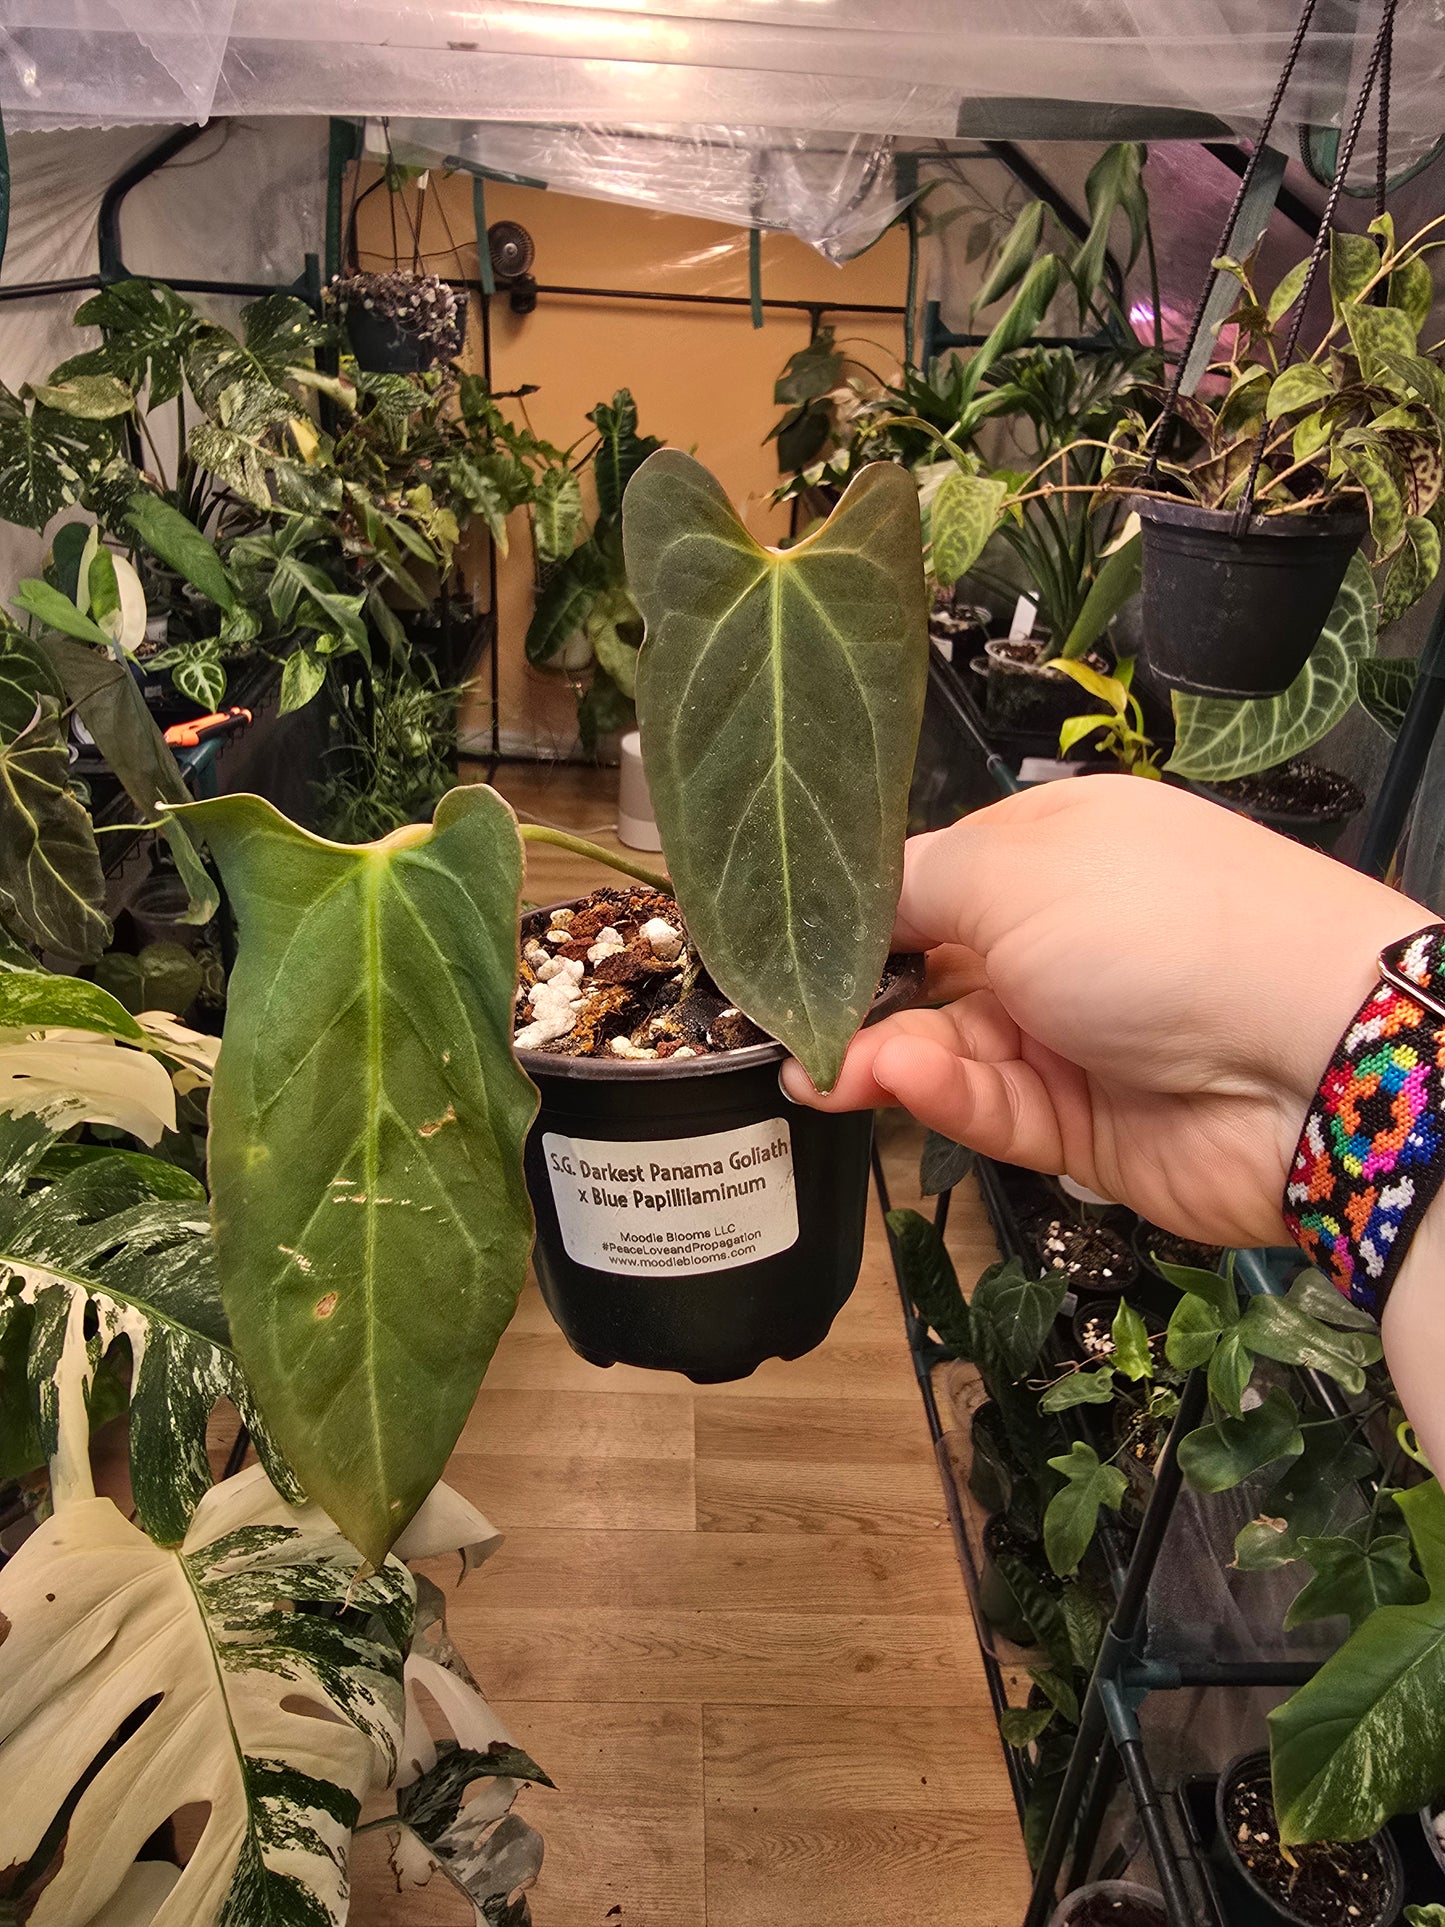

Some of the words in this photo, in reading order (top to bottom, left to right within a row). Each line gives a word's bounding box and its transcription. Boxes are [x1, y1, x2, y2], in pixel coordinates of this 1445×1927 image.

[550, 1153, 576, 1175] S.G.
[580, 1160, 644, 1182] Darkest
[650, 1159, 723, 1182] Panama
[729, 1139, 788, 1170] Goliath
[592, 1188, 627, 1207] Blue
[634, 1175, 766, 1211] Papillilaminum
[602, 1229, 762, 1255] #PeaceLoveandPropagation
[667, 1229, 710, 1242] Blooms
[714, 1223, 736, 1236] LLC
